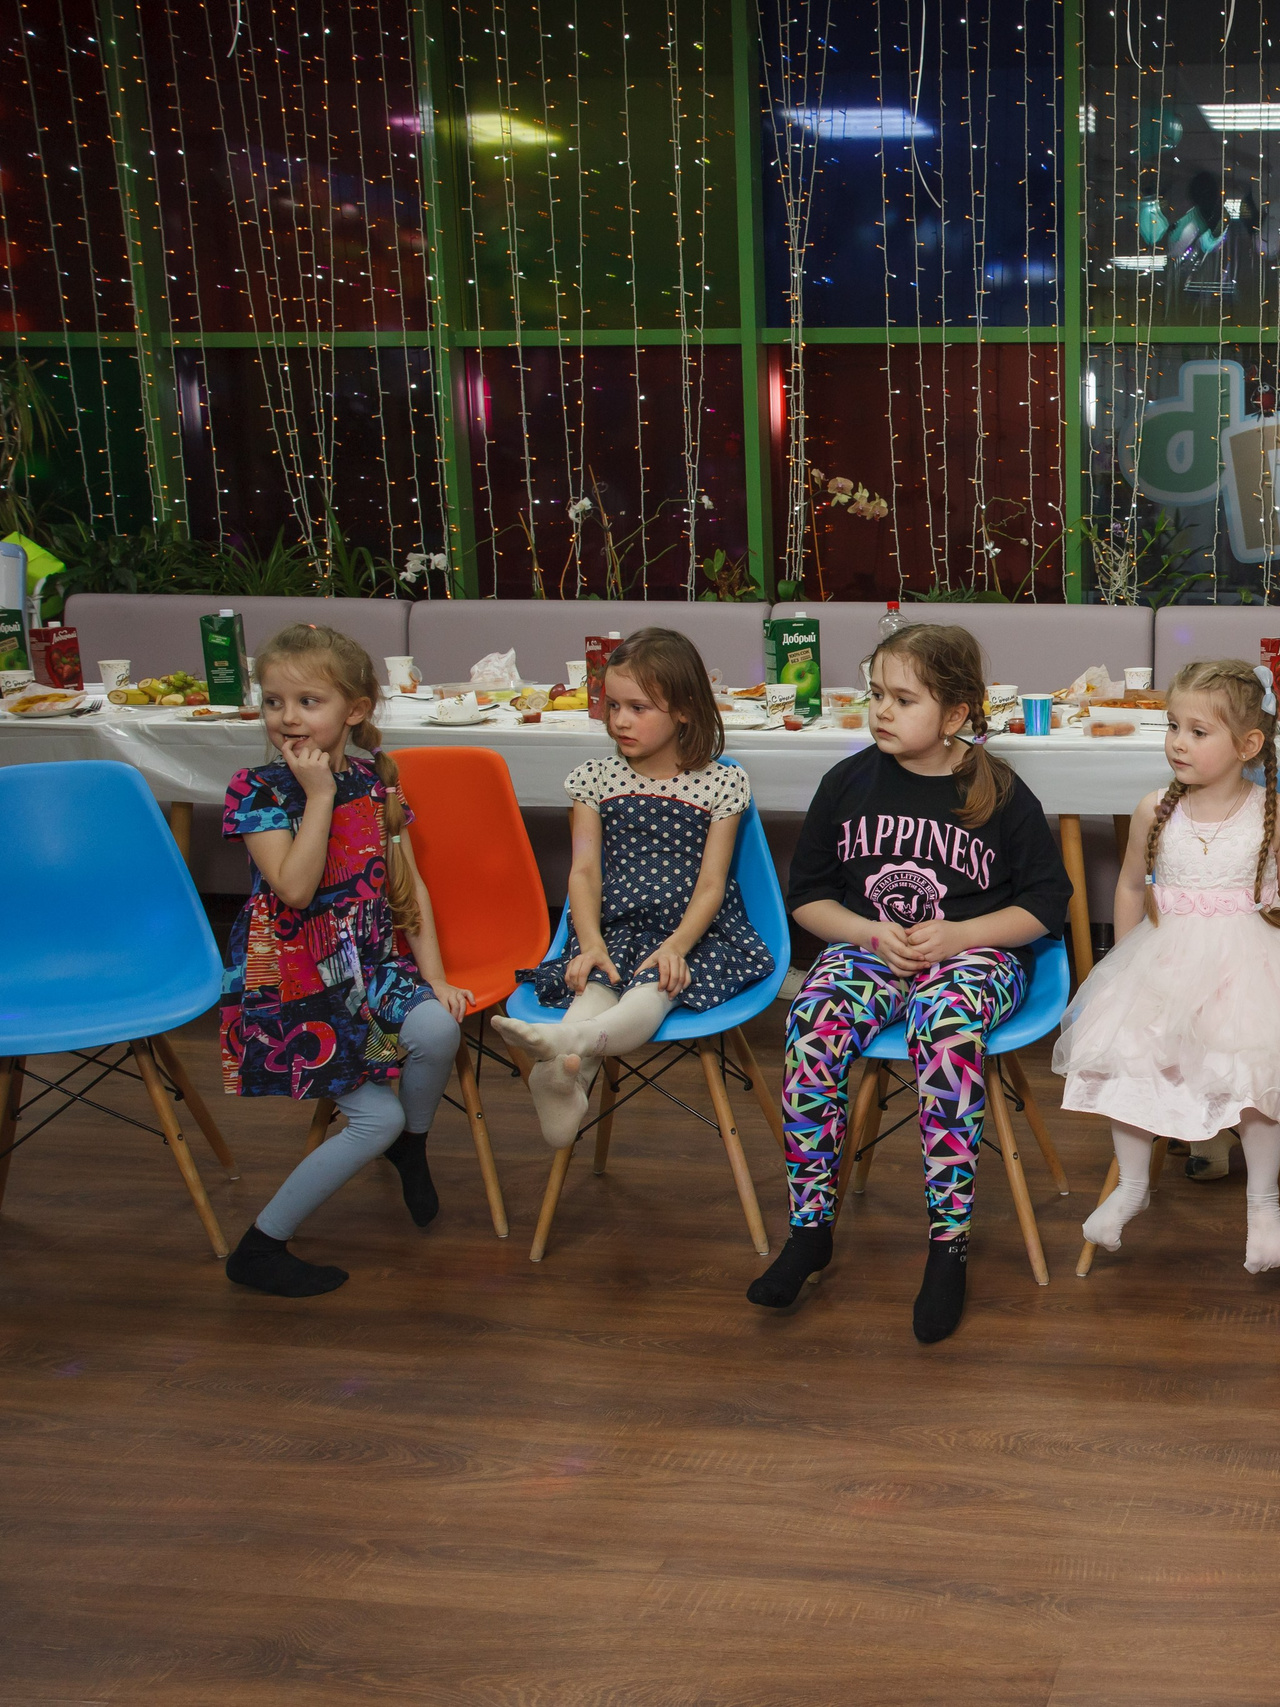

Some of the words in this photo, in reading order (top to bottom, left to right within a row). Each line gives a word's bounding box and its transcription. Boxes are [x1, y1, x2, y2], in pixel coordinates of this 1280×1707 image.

[0, 621, 21, 634] брый
[782, 632, 816, 645] Добрый
[837, 815, 995, 890] HAPPINESS
[879, 876, 892, 888] DAY
[900, 873, 926, 887] LITTLE
